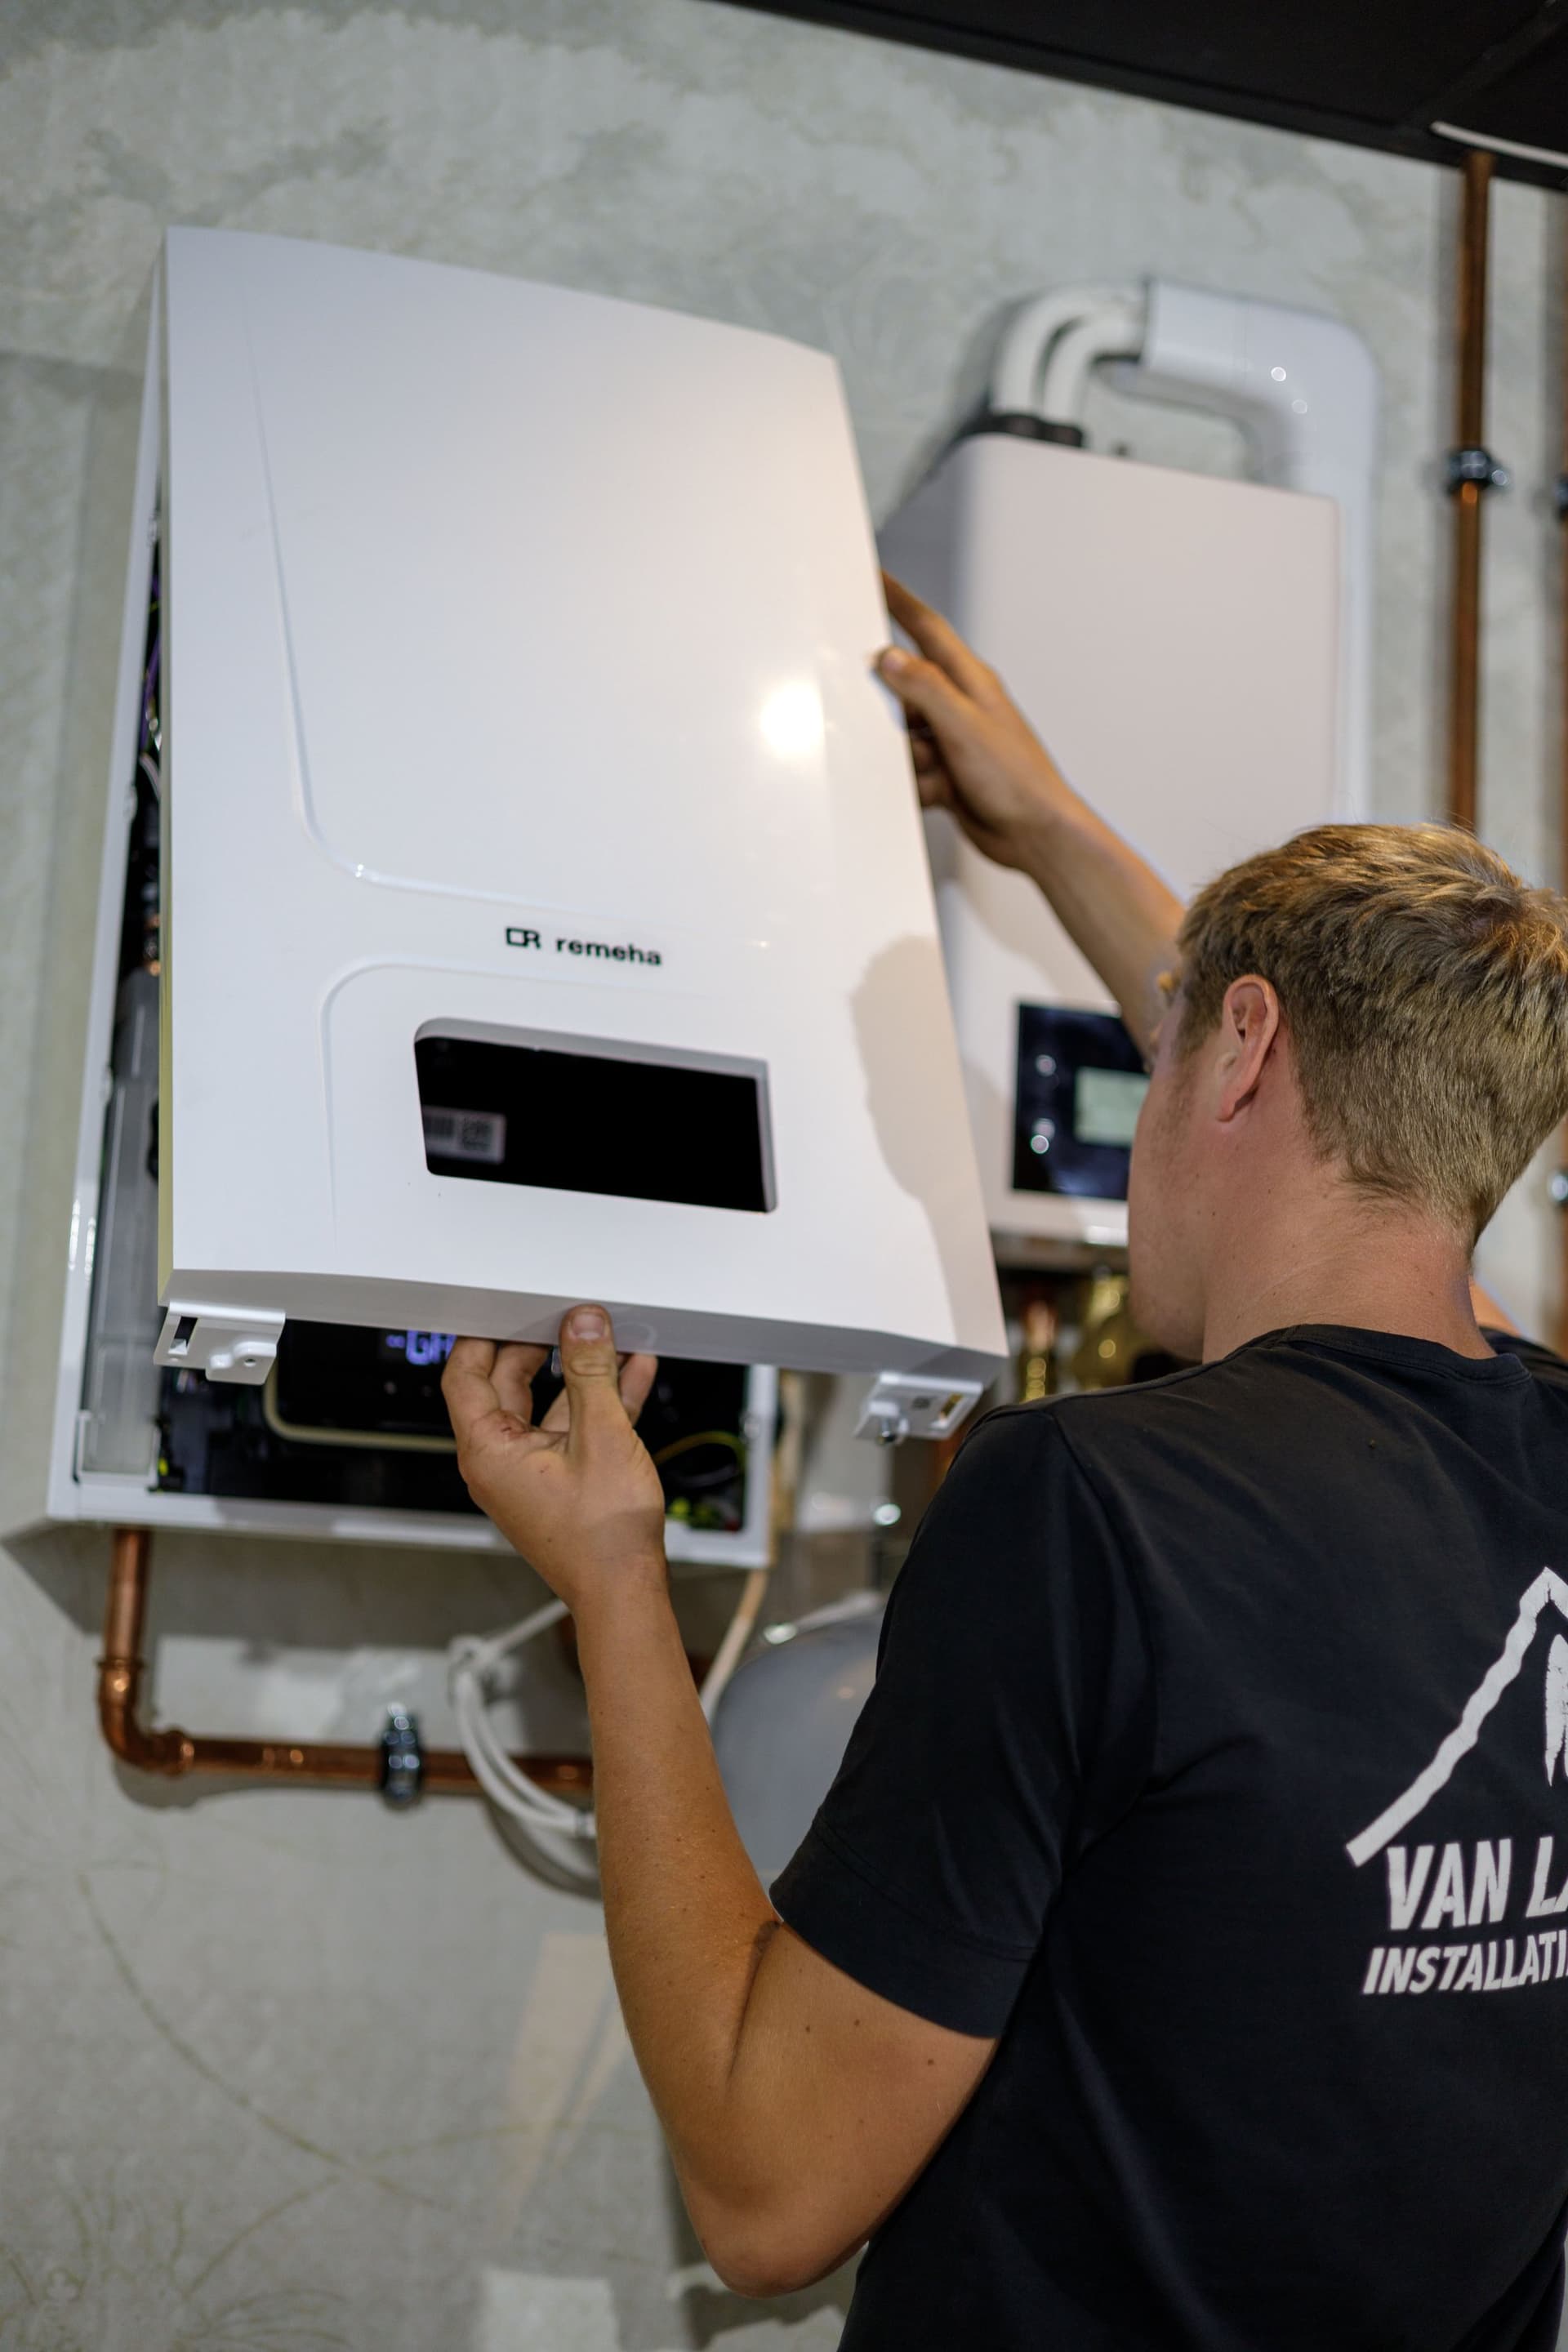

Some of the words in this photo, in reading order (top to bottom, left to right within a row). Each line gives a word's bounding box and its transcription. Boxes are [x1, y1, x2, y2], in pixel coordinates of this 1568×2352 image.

[555, 938, 662, 966] remeha
[1387, 1838, 1512, 1930] VAN
[1363, 1929, 1568, 1994] INSTALLATI
